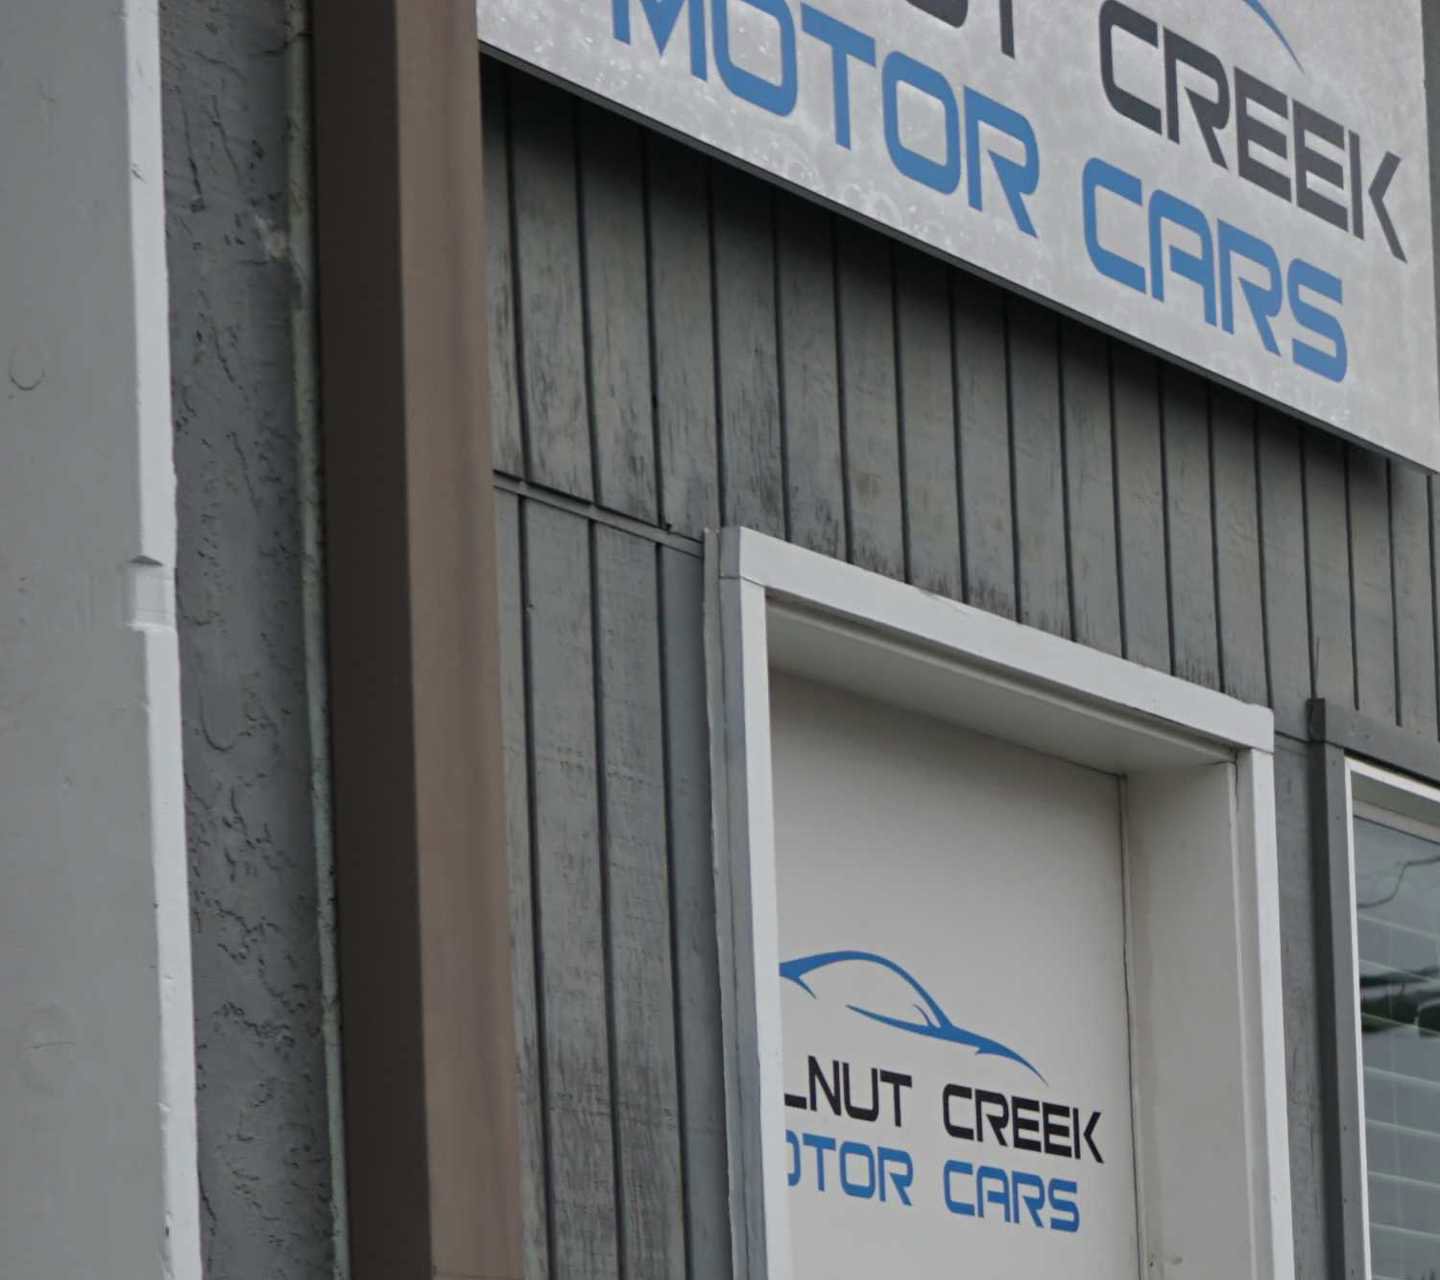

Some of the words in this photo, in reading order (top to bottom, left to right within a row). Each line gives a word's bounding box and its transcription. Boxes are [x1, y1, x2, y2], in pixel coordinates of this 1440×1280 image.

[1098, 0, 1407, 264] CREEK
[1082, 157, 1348, 383] CARS
[942, 1083, 1104, 1164] CREEK
[943, 1160, 1081, 1233] CARS
